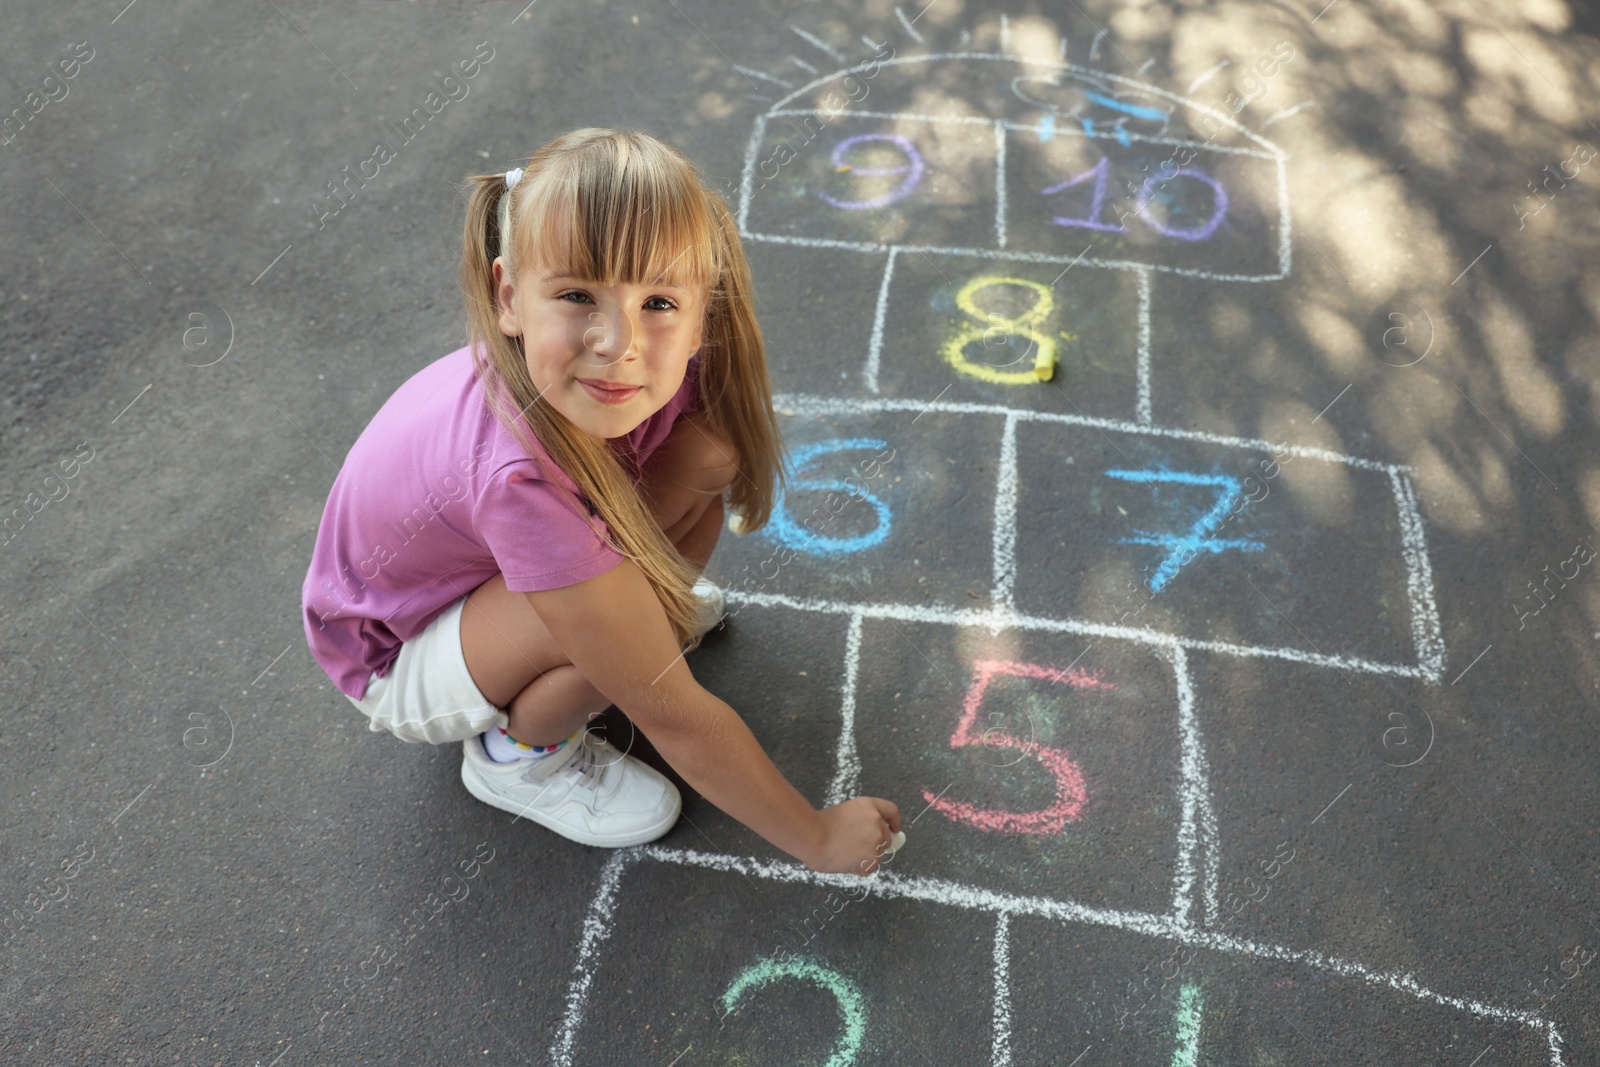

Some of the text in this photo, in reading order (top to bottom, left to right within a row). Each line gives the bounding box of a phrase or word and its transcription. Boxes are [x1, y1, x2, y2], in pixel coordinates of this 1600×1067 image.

[819, 133, 926, 210] 9
[1041, 155, 1228, 240] 10
[940, 275, 1058, 384] 8
[762, 437, 892, 557] 6
[1104, 468, 1268, 594] 7
[921, 659, 1117, 836] 5
